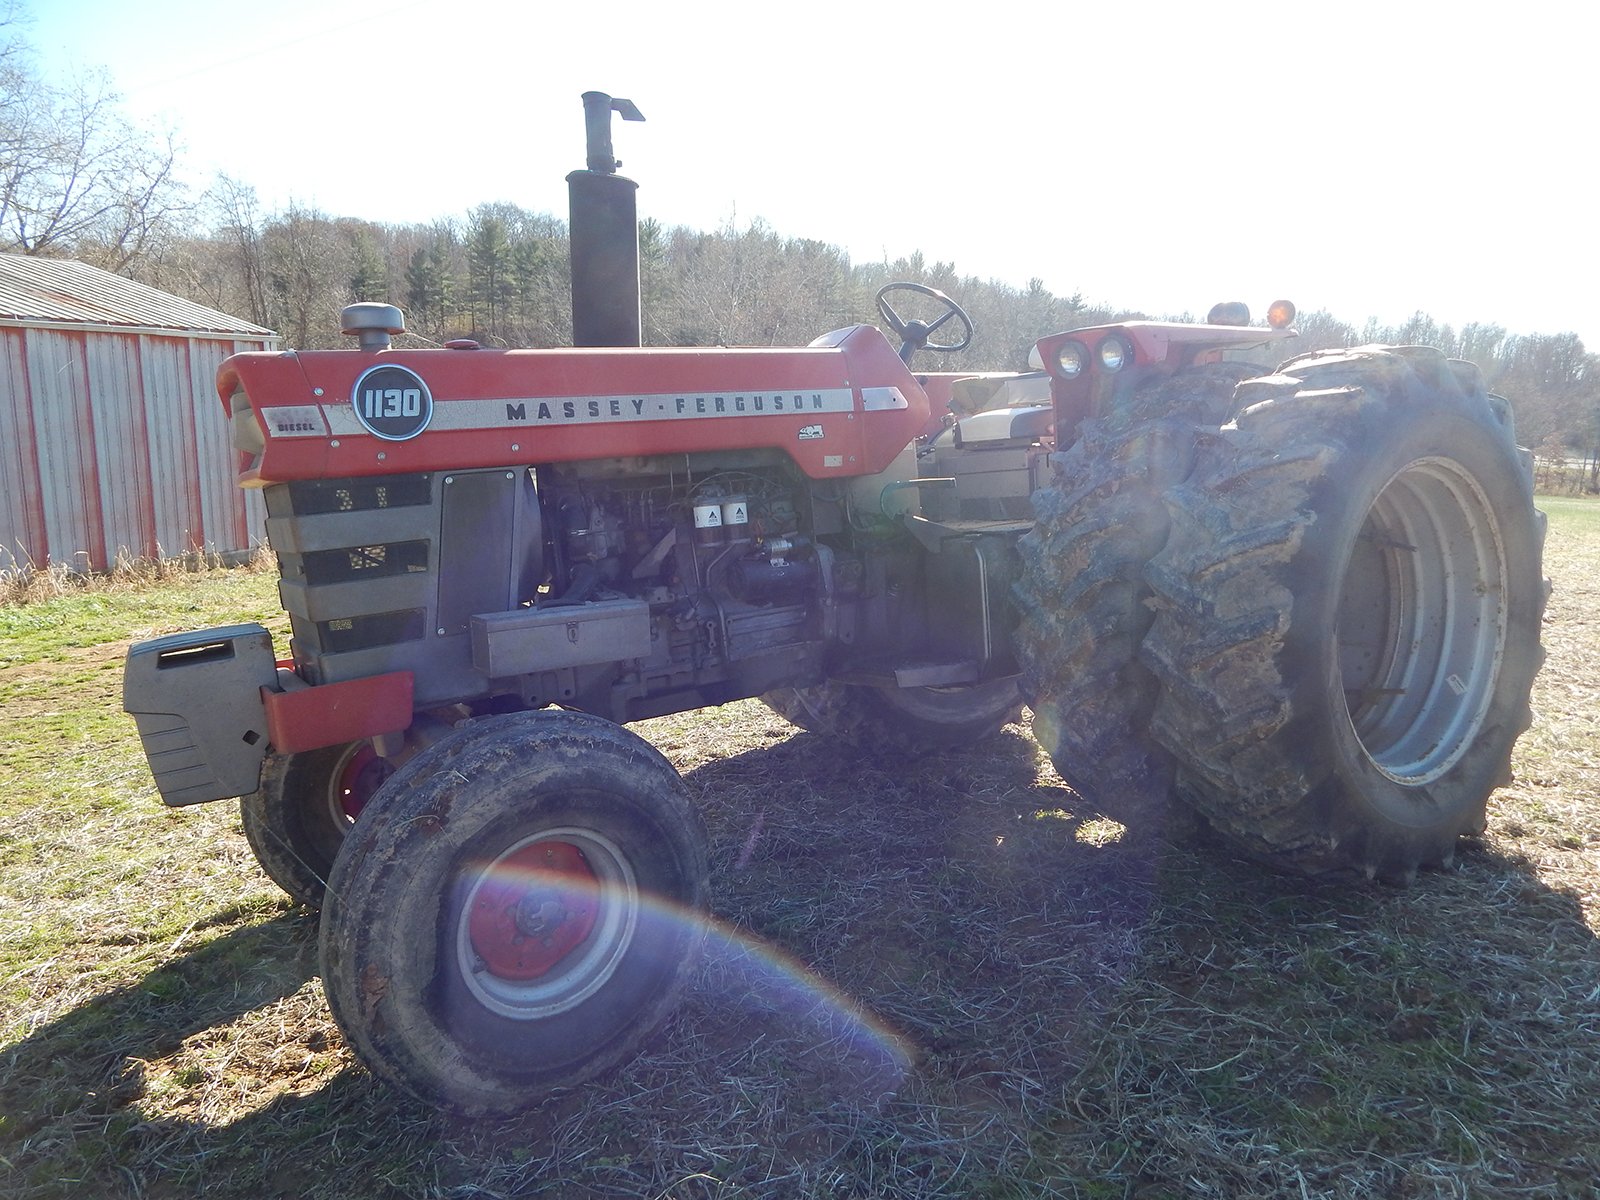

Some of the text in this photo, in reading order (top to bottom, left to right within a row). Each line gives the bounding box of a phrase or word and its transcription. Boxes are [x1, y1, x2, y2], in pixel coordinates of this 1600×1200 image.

[365, 388, 420, 419] 1130
[506, 394, 823, 421] MASSEY FERGUSON
[277, 423, 315, 432] DIESEL
